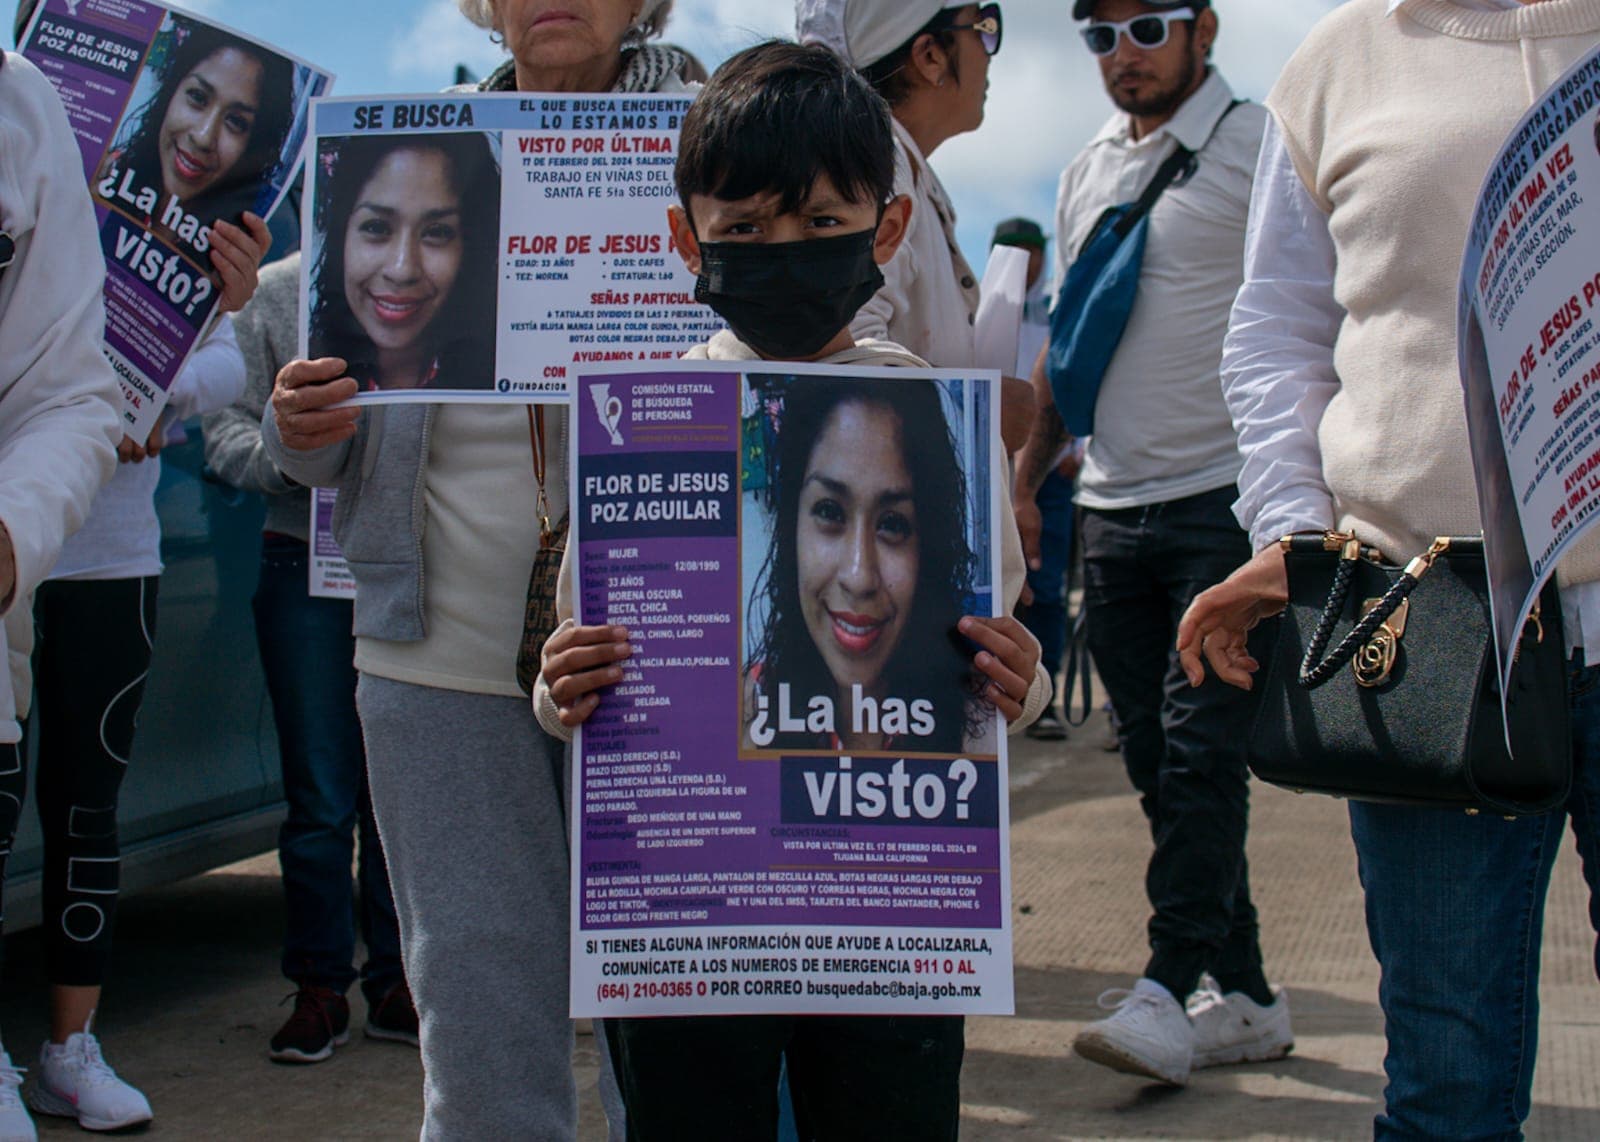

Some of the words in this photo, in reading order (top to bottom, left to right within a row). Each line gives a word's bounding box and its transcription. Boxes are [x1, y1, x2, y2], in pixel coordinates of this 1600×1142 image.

[40, 21, 74, 39] FLOR
[76, 32, 96, 46] DE
[96, 39, 139, 61] JESUS
[38, 35, 66, 51] POZ
[68, 44, 128, 72] AGUILAR
[520, 100, 535, 111] EL
[541, 101, 566, 111] QUE
[573, 100, 615, 112] BUSCA
[622, 100, 691, 112] ENCUENTR
[354, 107, 384, 128] SE
[392, 104, 473, 128] BUSCA
[541, 116, 561, 129] LO
[572, 115, 657, 129] ESTAMOS
[1501, 106, 1549, 170] ENCUENTRA
[1549, 96, 1557, 110] Y
[518, 137, 565, 153] VISTO
[572, 137, 604, 153] POR
[611, 133, 672, 153] ÚLTIMA
[523, 158, 531, 166] 17
[534, 158, 544, 166] DE
[548, 158, 588, 166] FEBRERO
[527, 171, 581, 182] TRABAJO
[586, 172, 600, 182] EN
[606, 169, 642, 182] VIÑAS
[647, 171, 668, 181] DEL
[545, 187, 582, 198] SANTA
[588, 187, 602, 198] FE
[607, 187, 624, 197] 5ta
[629, 183, 677, 197] SECCIÓ
[1488, 155, 1529, 229] ESTAMOS
[1494, 220, 1510, 257] POR
[1508, 172, 1547, 229] ÚLTIMA
[1546, 142, 1574, 181] VEZ
[98, 168, 157, 214] ¿La
[161, 194, 211, 252] has
[1540, 215, 1557, 238] DEL
[507, 235, 557, 254] FLOR
[565, 235, 591, 253] DE
[599, 235, 660, 253] JESUS
[1535, 221, 1576, 269] SECCIÓN.
[554, 258, 574, 267] AÑOS
[115, 226, 211, 316] visto?
[591, 290, 628, 304] SEÑAS
[634, 293, 697, 304] PARTICUL
[671, 310, 703, 318] PIERNAS
[511, 321, 537, 330] VESTÍA
[1571, 319, 1593, 344] CAFES
[1499, 370, 1521, 425] FLOR
[1520, 343, 1537, 382] DE
[1540, 295, 1582, 356] JESUS
[544, 367, 565, 378] CON
[113, 360, 155, 402] LOCALIZARLA,
[513, 382, 566, 391] FUNDACION
[632, 384, 674, 395] COMISIÓN
[677, 384, 714, 394] ESTATAL
[632, 399, 643, 408] DE
[645, 396, 693, 408] BÚSQUEDA
[1553, 382, 1582, 419] SEÑAS
[632, 412, 643, 421] DE
[645, 411, 692, 420] PERSONAS
[585, 475, 632, 496] FLOR
[638, 474, 663, 493] DE
[668, 473, 729, 493] JESUS
[591, 503, 628, 523] POZ
[634, 501, 720, 520] AGUILAR
[1551, 504, 1567, 529] CON
[1567, 486, 1588, 510] UNA
[609, 548, 638, 559] MUJER
[674, 561, 719, 571] 12/08/1990
[608, 577, 618, 587] 33
[620, 574, 644, 586] AÑOS
[608, 591, 644, 601] MORENA
[647, 590, 683, 600] OSCURA
[608, 604, 638, 614] RECTA,
[640, 603, 667, 613] CHICA
[642, 615, 686, 624] RASGADOS,
[648, 629, 675, 639] CHINO,
[677, 629, 703, 638] LARGO
[640, 658, 664, 666] HACIA
[616, 685, 655, 695] DELGADOS
[635, 698, 670, 706] DELGADA
[750, 682, 834, 746] ¿La
[852, 684, 936, 736] has
[598, 753, 621, 762] BRAZO
[623, 752, 658, 762] DERECHO
[612, 765, 651, 774] IZQUIERDO
[586, 779, 611, 788] PIERNA
[614, 777, 648, 787] DERECHA
[668, 776, 703, 784] LEYENDA
[803, 756, 978, 819] visto?
[586, 790, 634, 800] PANTORRILLA
[637, 788, 677, 797] IZQUIERDA
[628, 815, 648, 823] DEDO
[718, 812, 741, 820] MANO
[783, 841, 804, 849] VISTA
[899, 844, 930, 852] FEBRERO
[834, 853, 864, 861] TIJUANA
[866, 853, 884, 862] BAJA
[886, 854, 928, 863] CALIFORNIA
[713, 872, 754, 882] PANTALON
[644, 886, 678, 896] MOCHILA
[680, 885, 726, 895] CAMUFLAJE
[811, 897, 844, 907] TARJETA
[586, 913, 611, 923] COLOR
[650, 910, 679, 920] FRENTE
[682, 910, 708, 919] NEGRO
[586, 940, 597, 954] SI
[602, 938, 645, 953] TIENES
[650, 937, 703, 951] ALGUNA
[708, 933, 800, 950] INFORMACIÓN
[805, 936, 832, 950] QUE
[837, 936, 880, 950] AYUDE
[899, 937, 992, 955] LOCALIZARLA,
[602, 958, 685, 975] COMUNÍCATE
[703, 959, 727, 973] LOS
[732, 958, 797, 972] NUMEROS
[802, 959, 819, 972] DE
[824, 959, 910, 973] EMERGENCIA
[914, 960, 937, 973] 911
[958, 960, 976, 974] AL
[597, 983, 629, 1003] (664)
[634, 981, 692, 998] 210-0365
[697, 981, 707, 996] O
[711, 981, 739, 995] POR
[744, 980, 802, 995] CORREO
[807, 980, 981, 999] busquedabc@baja.gob.mx
